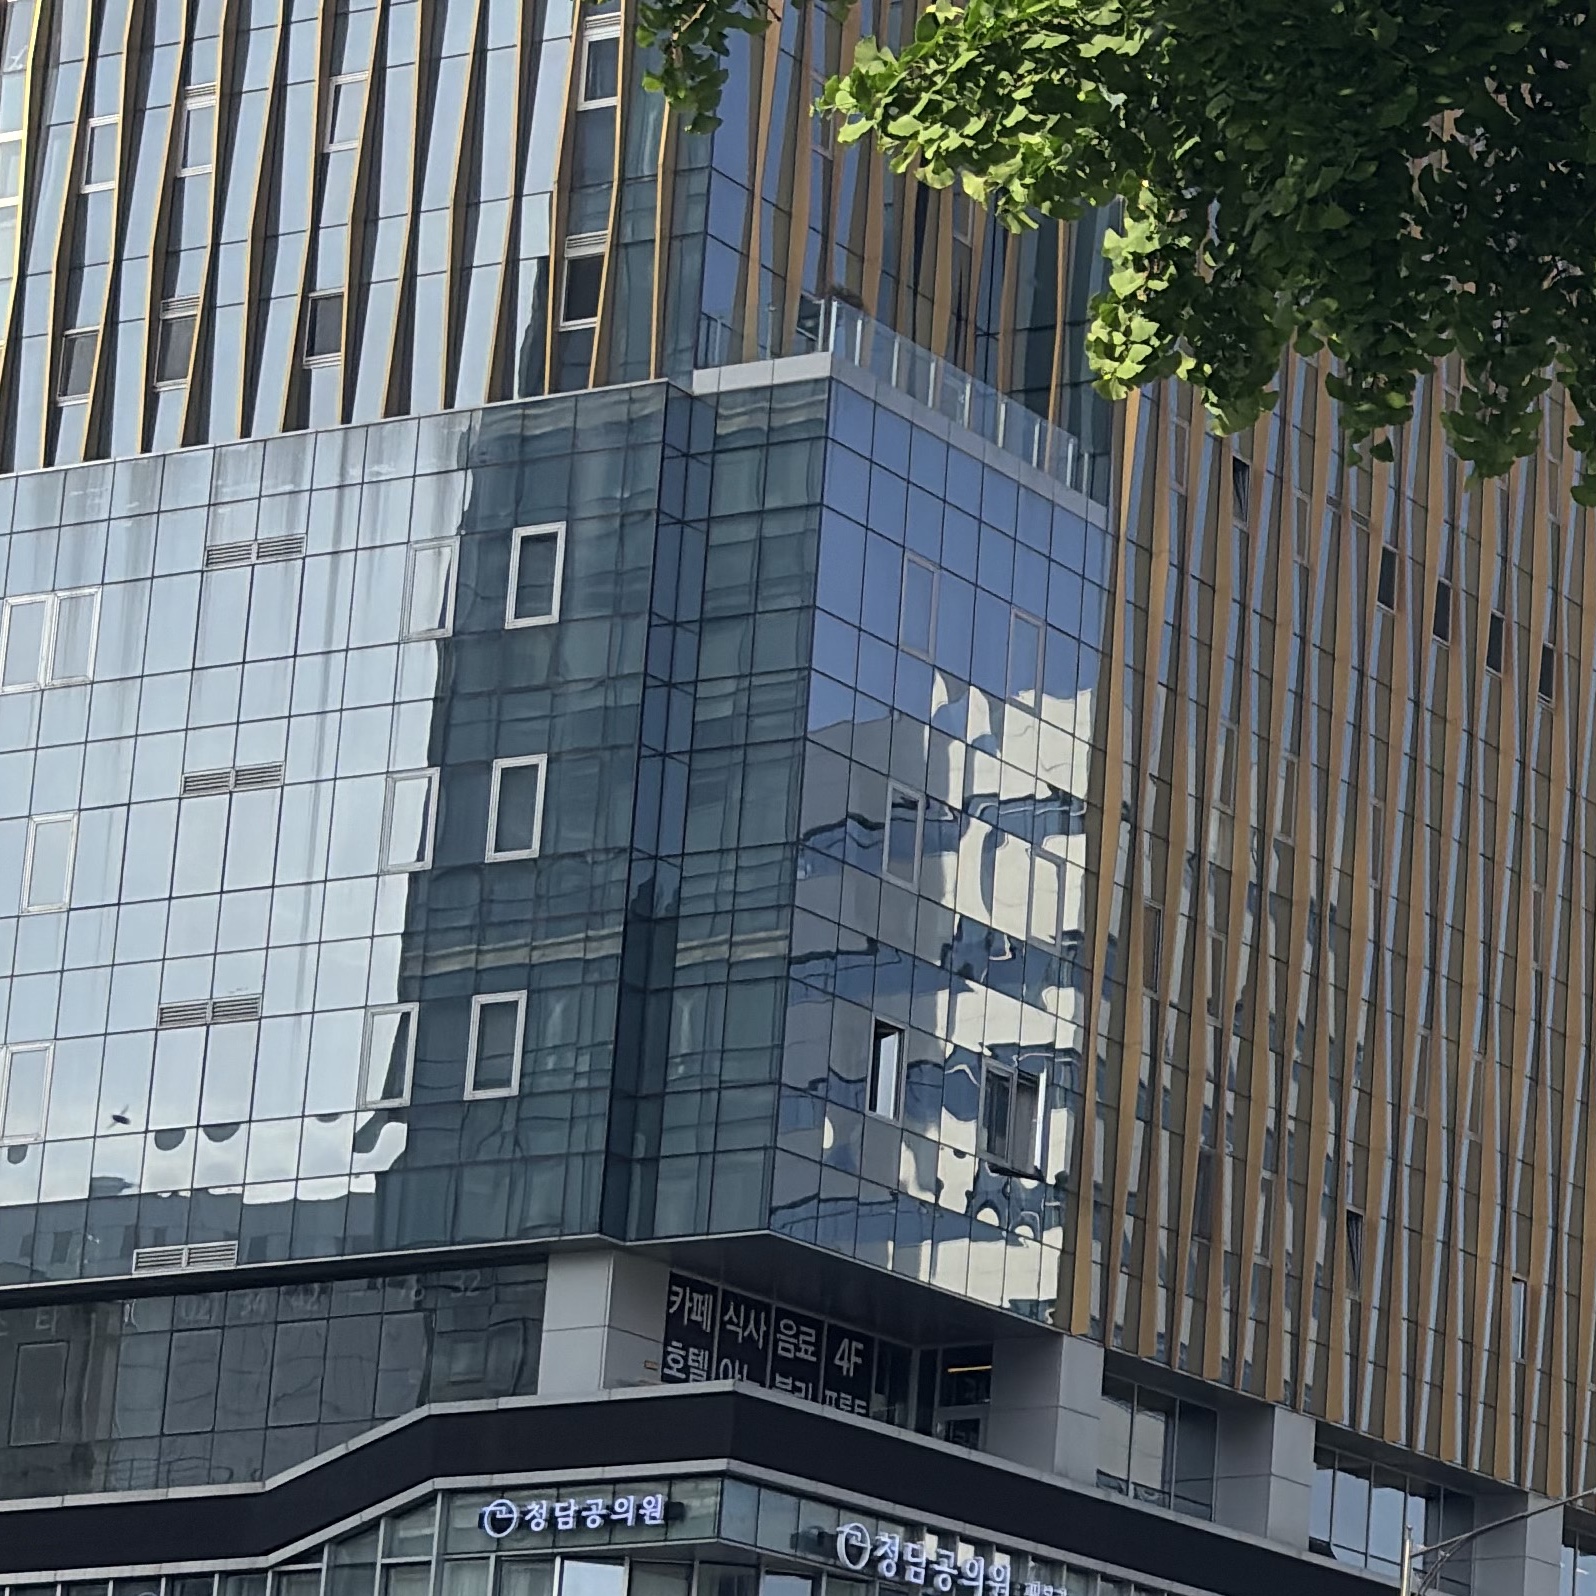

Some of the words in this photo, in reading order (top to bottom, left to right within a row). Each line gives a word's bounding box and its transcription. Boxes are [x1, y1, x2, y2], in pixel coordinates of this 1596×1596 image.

[668, 1285, 714, 1333] 카페
[723, 1302, 766, 1350] 식사
[776, 1319, 817, 1362] 음료
[834, 1337, 864, 1377] 4F
[525, 1494, 665, 1532] 청담공의원
